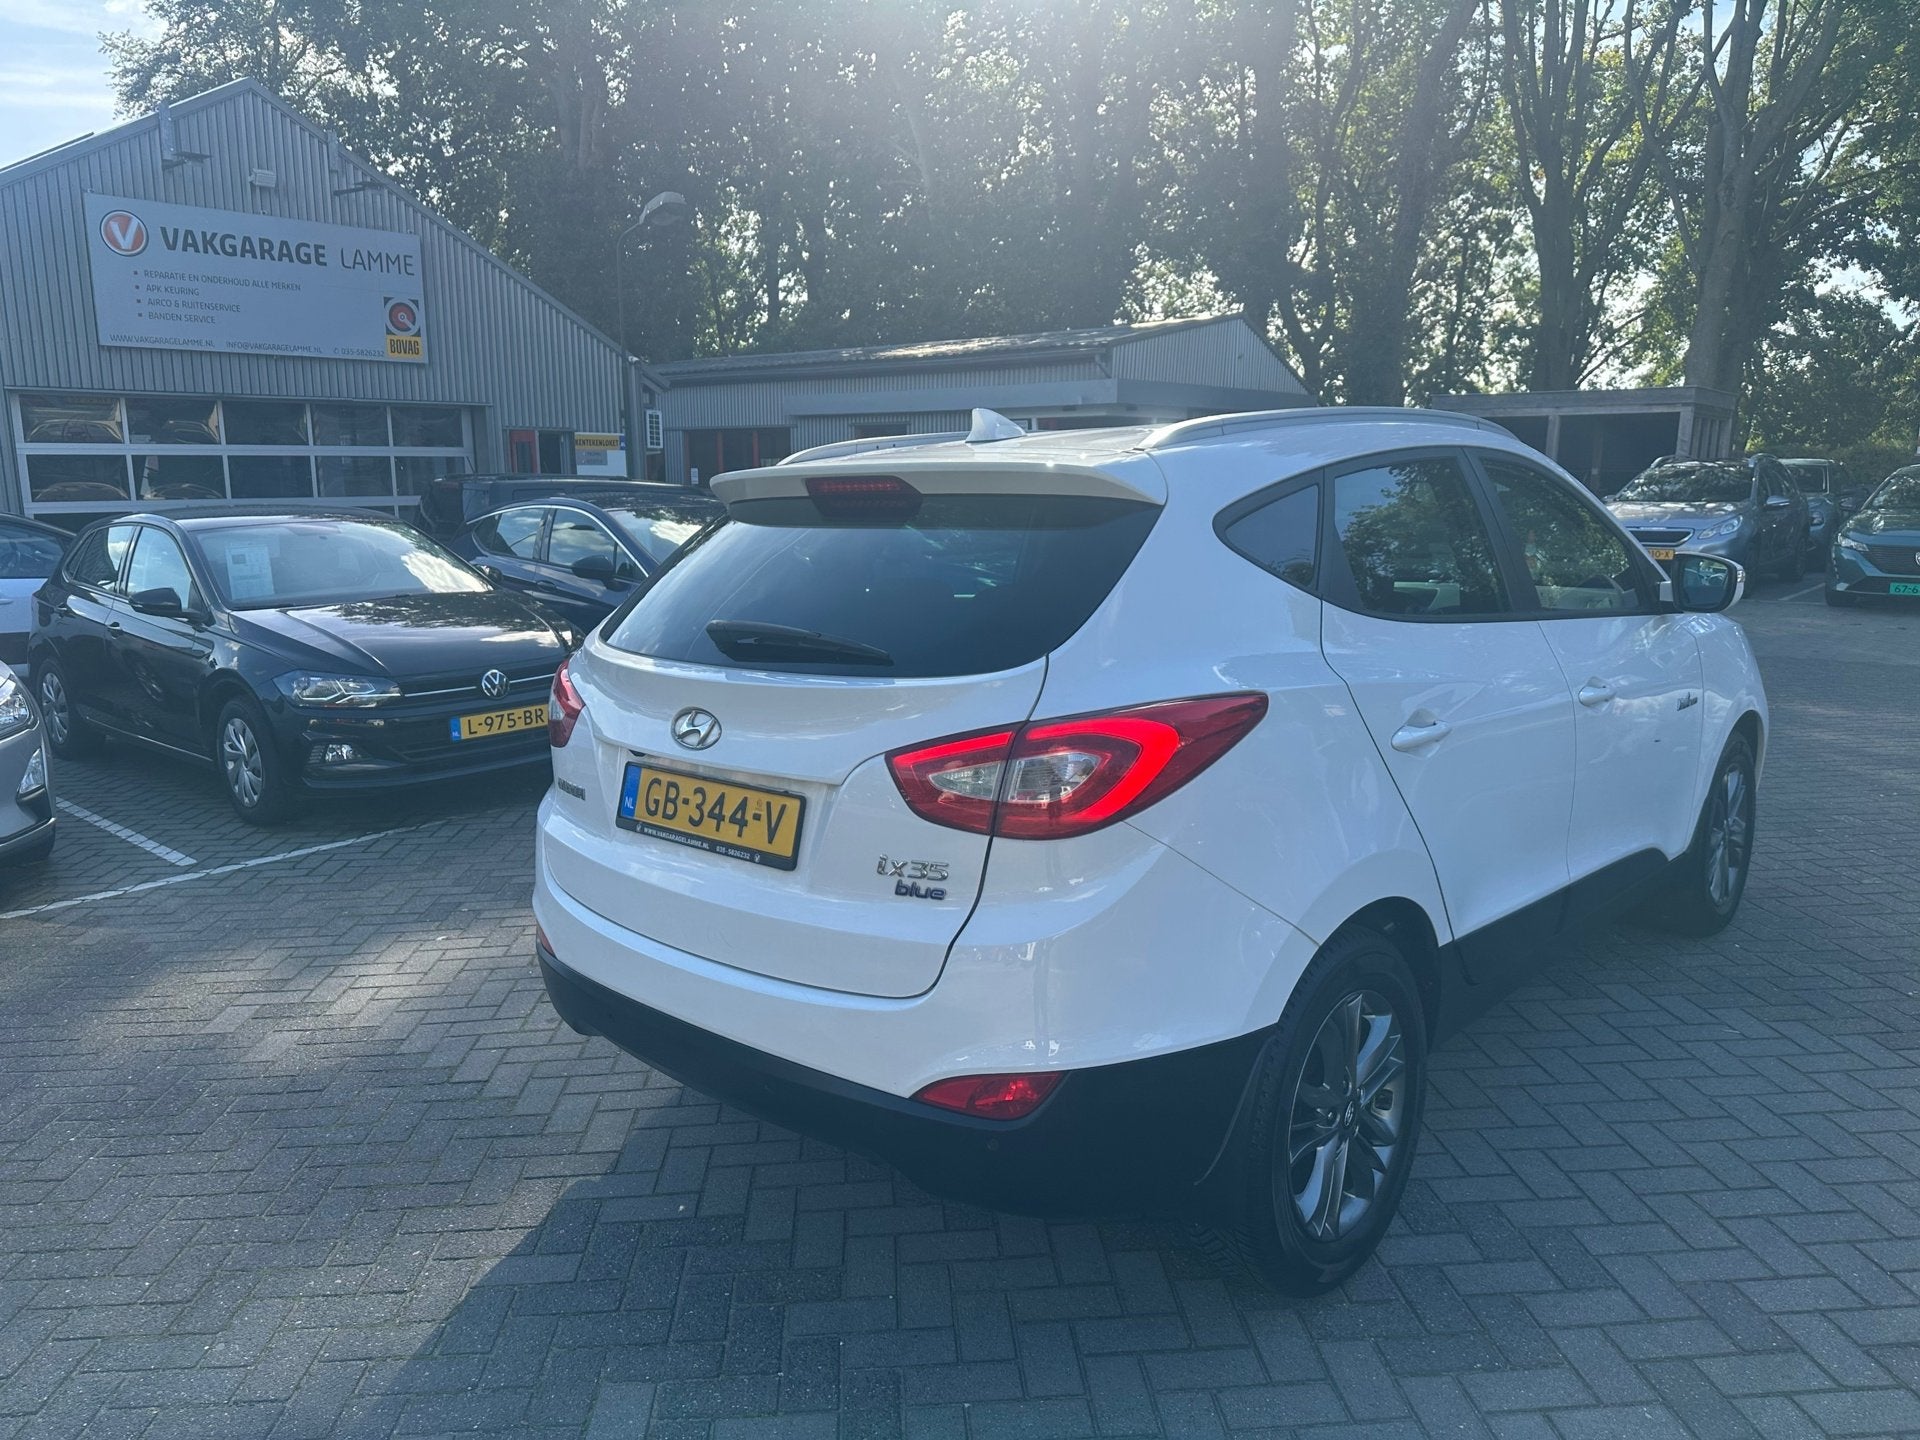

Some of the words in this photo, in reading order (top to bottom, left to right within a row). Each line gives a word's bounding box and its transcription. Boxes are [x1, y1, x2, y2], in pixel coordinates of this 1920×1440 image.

[160, 226, 327, 267] VAKGARAGE
[341, 247, 415, 276] LAMME
[144, 270, 186, 281] REPARATIE
[201, 275, 250, 287] ONDERHOUD
[251, 279, 269, 289] ALLE
[272, 281, 300, 291] MERKEN
[146, 284, 162, 293] APK
[164, 286, 200, 296] KEURING
[147, 298, 172, 308] AIRCO
[174, 299, 179, 308] &
[182, 300, 241, 313] RUITENSERVICE
[148, 311, 182, 321] BANDEN
[184, 314, 216, 324] SERVICE
[109, 333, 215, 348] WWW.VAKGARAGELAMME.NL
[389, 338, 420, 355] BOVAG
[467, 708, 545, 735] L-975-BR
[624, 796, 634, 810] NL
[645, 777, 788, 845] GB-344-V
[895, 879, 947, 900] blue
